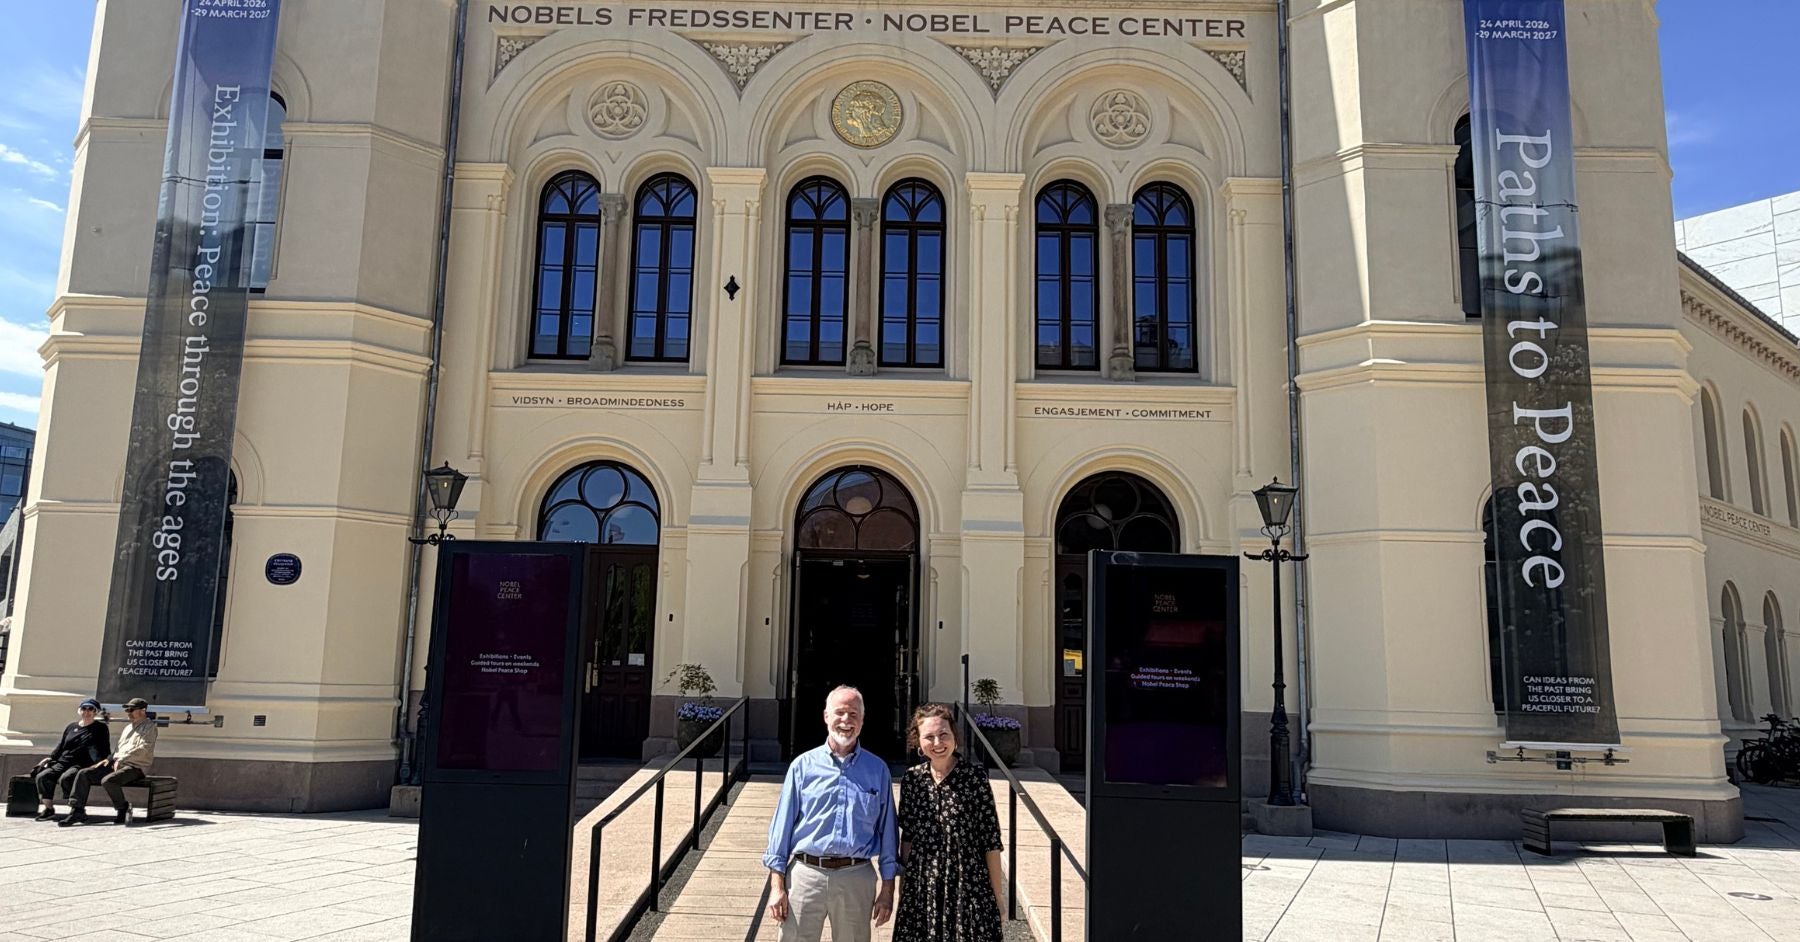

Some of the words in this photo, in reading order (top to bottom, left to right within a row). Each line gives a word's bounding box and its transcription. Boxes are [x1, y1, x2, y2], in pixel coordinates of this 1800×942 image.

[243, 0, 267, 8] 2026
[191, 8, 207, 17] -29
[209, 10, 247, 18] MARCH
[249, 9, 271, 19] 2027
[488, 5, 613, 26] NOBELS
[628, 9, 854, 30] FREDSSENTER
[883, 14, 990, 33] NOBEL
[1004, 16, 1110, 35] PEACE
[1118, 18, 1245, 38] CENTER
[1480, 20, 1492, 28] 24
[1494, 20, 1524, 28] APRIL
[1525, 20, 1549, 29] 2026
[1475, 30, 1490, 39] -29
[1492, 31, 1531, 39] MARCH
[1533, 31, 1558, 40] 2027
[199, 84, 241, 236] Exhibition:
[1495, 128, 1565, 295] Paths
[188, 245, 222, 327] Peace
[1506, 316, 1559, 379] to
[167, 334, 210, 450] through
[512, 396, 554, 405] VIDSYN
[567, 397, 685, 407] BROADMINDEDNESS
[827, 401, 852, 411] HÅP
[861, 403, 894, 412] HOPE
[1034, 407, 1122, 417] ENGASJEMENT
[1131, 409, 1211, 418] COMMITMENT
[165, 458, 197, 506] the
[1512, 401, 1574, 589] Peace
[152, 515, 184, 582] ages
[126, 640, 144, 648] CAN
[169, 641, 193, 649] FROM
[128, 649, 143, 657] THE
[164, 650, 188, 658] BRING
[138, 659, 168, 667] CLOSER
[117, 667, 158, 676] PEACEFUL
[159, 668, 193, 677] FUTURE?
[1568, 677, 1595, 685] FROM
[1527, 685, 1543, 693] THE
[1565, 686, 1592, 694] BRING
[1528, 695, 1539, 703] US
[1540, 695, 1571, 703] CLOSER
[1521, 704, 1563, 713] PEACEFUL
[1563, 705, 1600, 713] FUTURE?
